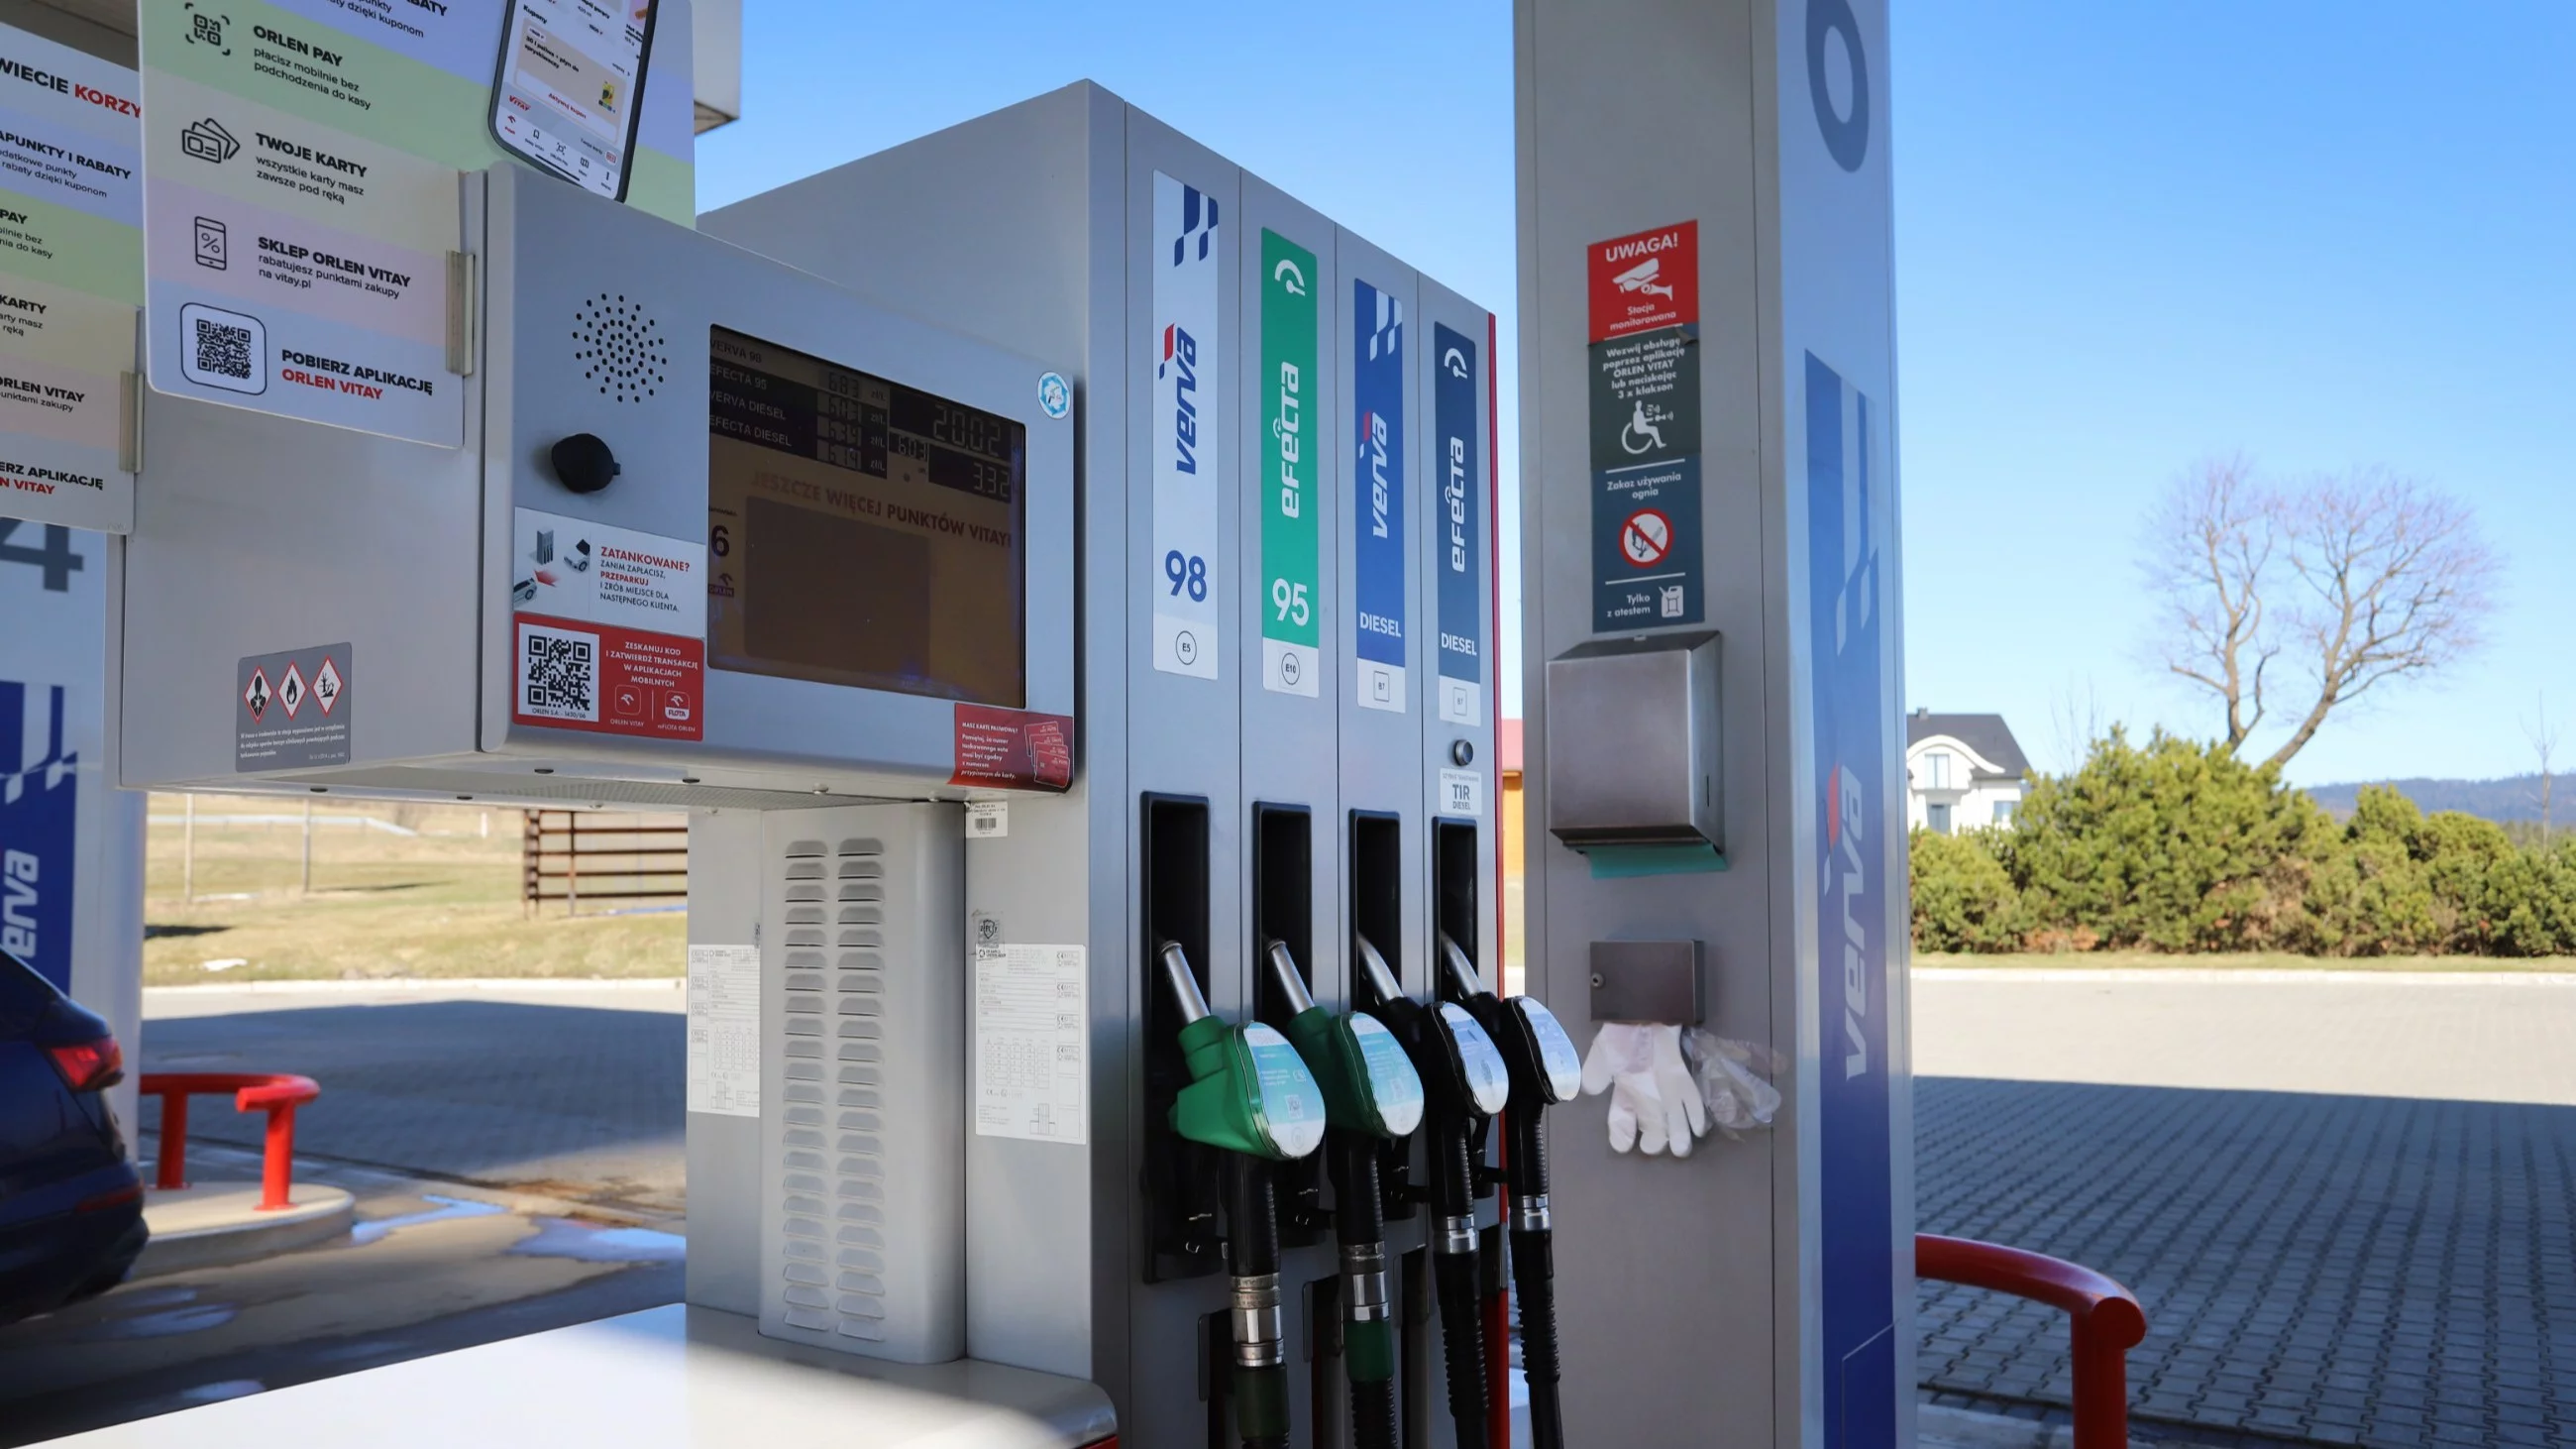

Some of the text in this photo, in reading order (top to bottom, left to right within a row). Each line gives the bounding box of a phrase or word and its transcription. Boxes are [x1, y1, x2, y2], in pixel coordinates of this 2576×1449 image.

[348, 2, 424, 38] dzięki kuponom
[254, 25, 343, 66] ORLEN PAY
[254, 48, 360, 92] płacisz mobilnie bez
[254, 60, 371, 110] podchodzenia do kasy
[256, 132, 367, 177] TWOJE KARTY
[46, 164, 77, 179] punkty
[68, 152, 72, 163] I
[76, 155, 132, 179] RABATY
[256, 156, 365, 195] wszystkie karty masz
[2, 161, 107, 198] rabaty dzięki kuponom
[257, 169, 345, 204] zawsze pod ręką
[0, 208, 28, 225] PAY
[25, 232, 43, 245] bez
[1605, 232, 1678, 263] UWAGA!
[16, 242, 29, 252] do
[32, 245, 53, 260] kasy
[258, 237, 411, 287] SKLEP ORLEN VITAY
[259, 254, 399, 299] rabatujesz punktami zakupy
[259, 268, 311, 289] na vitay.pl
[0, 294, 47, 314] KARTY
[1627, 303, 1656, 316] Stacja
[3, 324, 25, 337] ręką
[19, 317, 44, 330] masz
[1610, 311, 1676, 331] monitorowana
[1606, 337, 1681, 359] Wezwij obsługę
[1603, 347, 1684, 372] poprzez aplikację
[1613, 359, 1674, 379] ORLEN VITAY
[282, 349, 433, 396] POBIERZ APLIKACJĘ
[710, 364, 767, 390] EFECTA 95
[1611, 371, 1676, 390] lub naciskając
[45, 385, 85, 403] VITAY
[281, 368, 383, 400] ORLEN VITAY
[1618, 390, 1625, 399] 3
[1635, 382, 1673, 396] klakson
[41, 398, 73, 413] zakupy
[709, 390, 746, 408] VERVA
[749, 400, 787, 420] DIESEL
[1176, 326, 1196, 476] verva
[709, 415, 752, 436] EFECTA
[754, 426, 792, 446] DIESEL
[28, 467, 103, 491] APLIKACJĘ
[1372, 412, 1388, 539] verva
[1606, 473, 1681, 492] Zakaz używania
[14, 479, 55, 495] VITAY
[1632, 488, 1659, 501] ognia
[750, 471, 821, 501] JESZCZE
[825, 487, 882, 516] WIĘCEJ
[887, 503, 965, 536] PUNKTÓW
[710, 525, 729, 557] 6
[600, 546, 690, 572] ZATANKOWANE?
[599, 571, 649, 587] PRZEPARKUJ
[600, 560, 666, 579] ZANIM ZAPŁACISZ,
[1165, 550, 1207, 603] 98
[603, 581, 624, 594] ZRÓB
[625, 585, 654, 599] MIEJSCE
[656, 590, 669, 600] DLA
[1627, 594, 1651, 606] Tylko
[599, 593, 680, 613] NASTĘPNEGO KLIENTA.
[1272, 578, 1309, 626] 95
[1614, 607, 1651, 618] atestem
[1360, 612, 1401, 638] DIESEL
[625, 641, 682, 656] ZESKANUJ KOD
[1182, 643, 1191, 653] E5
[1441, 631, 1477, 656] DIESEL
[610, 650, 652, 663] ZATWIERDŹ
[654, 656, 698, 670] TRANSAKCJĘ
[1285, 663, 1296, 674] E10
[632, 664, 682, 678] APLIKACJACH
[630, 675, 675, 688] MOBILNYCH
[668, 709, 687, 718] FLOTA
[1452, 783, 1470, 800] TIR
[1452, 801, 1471, 810] DIESEL
[1841, 764, 1867, 1082] verva
